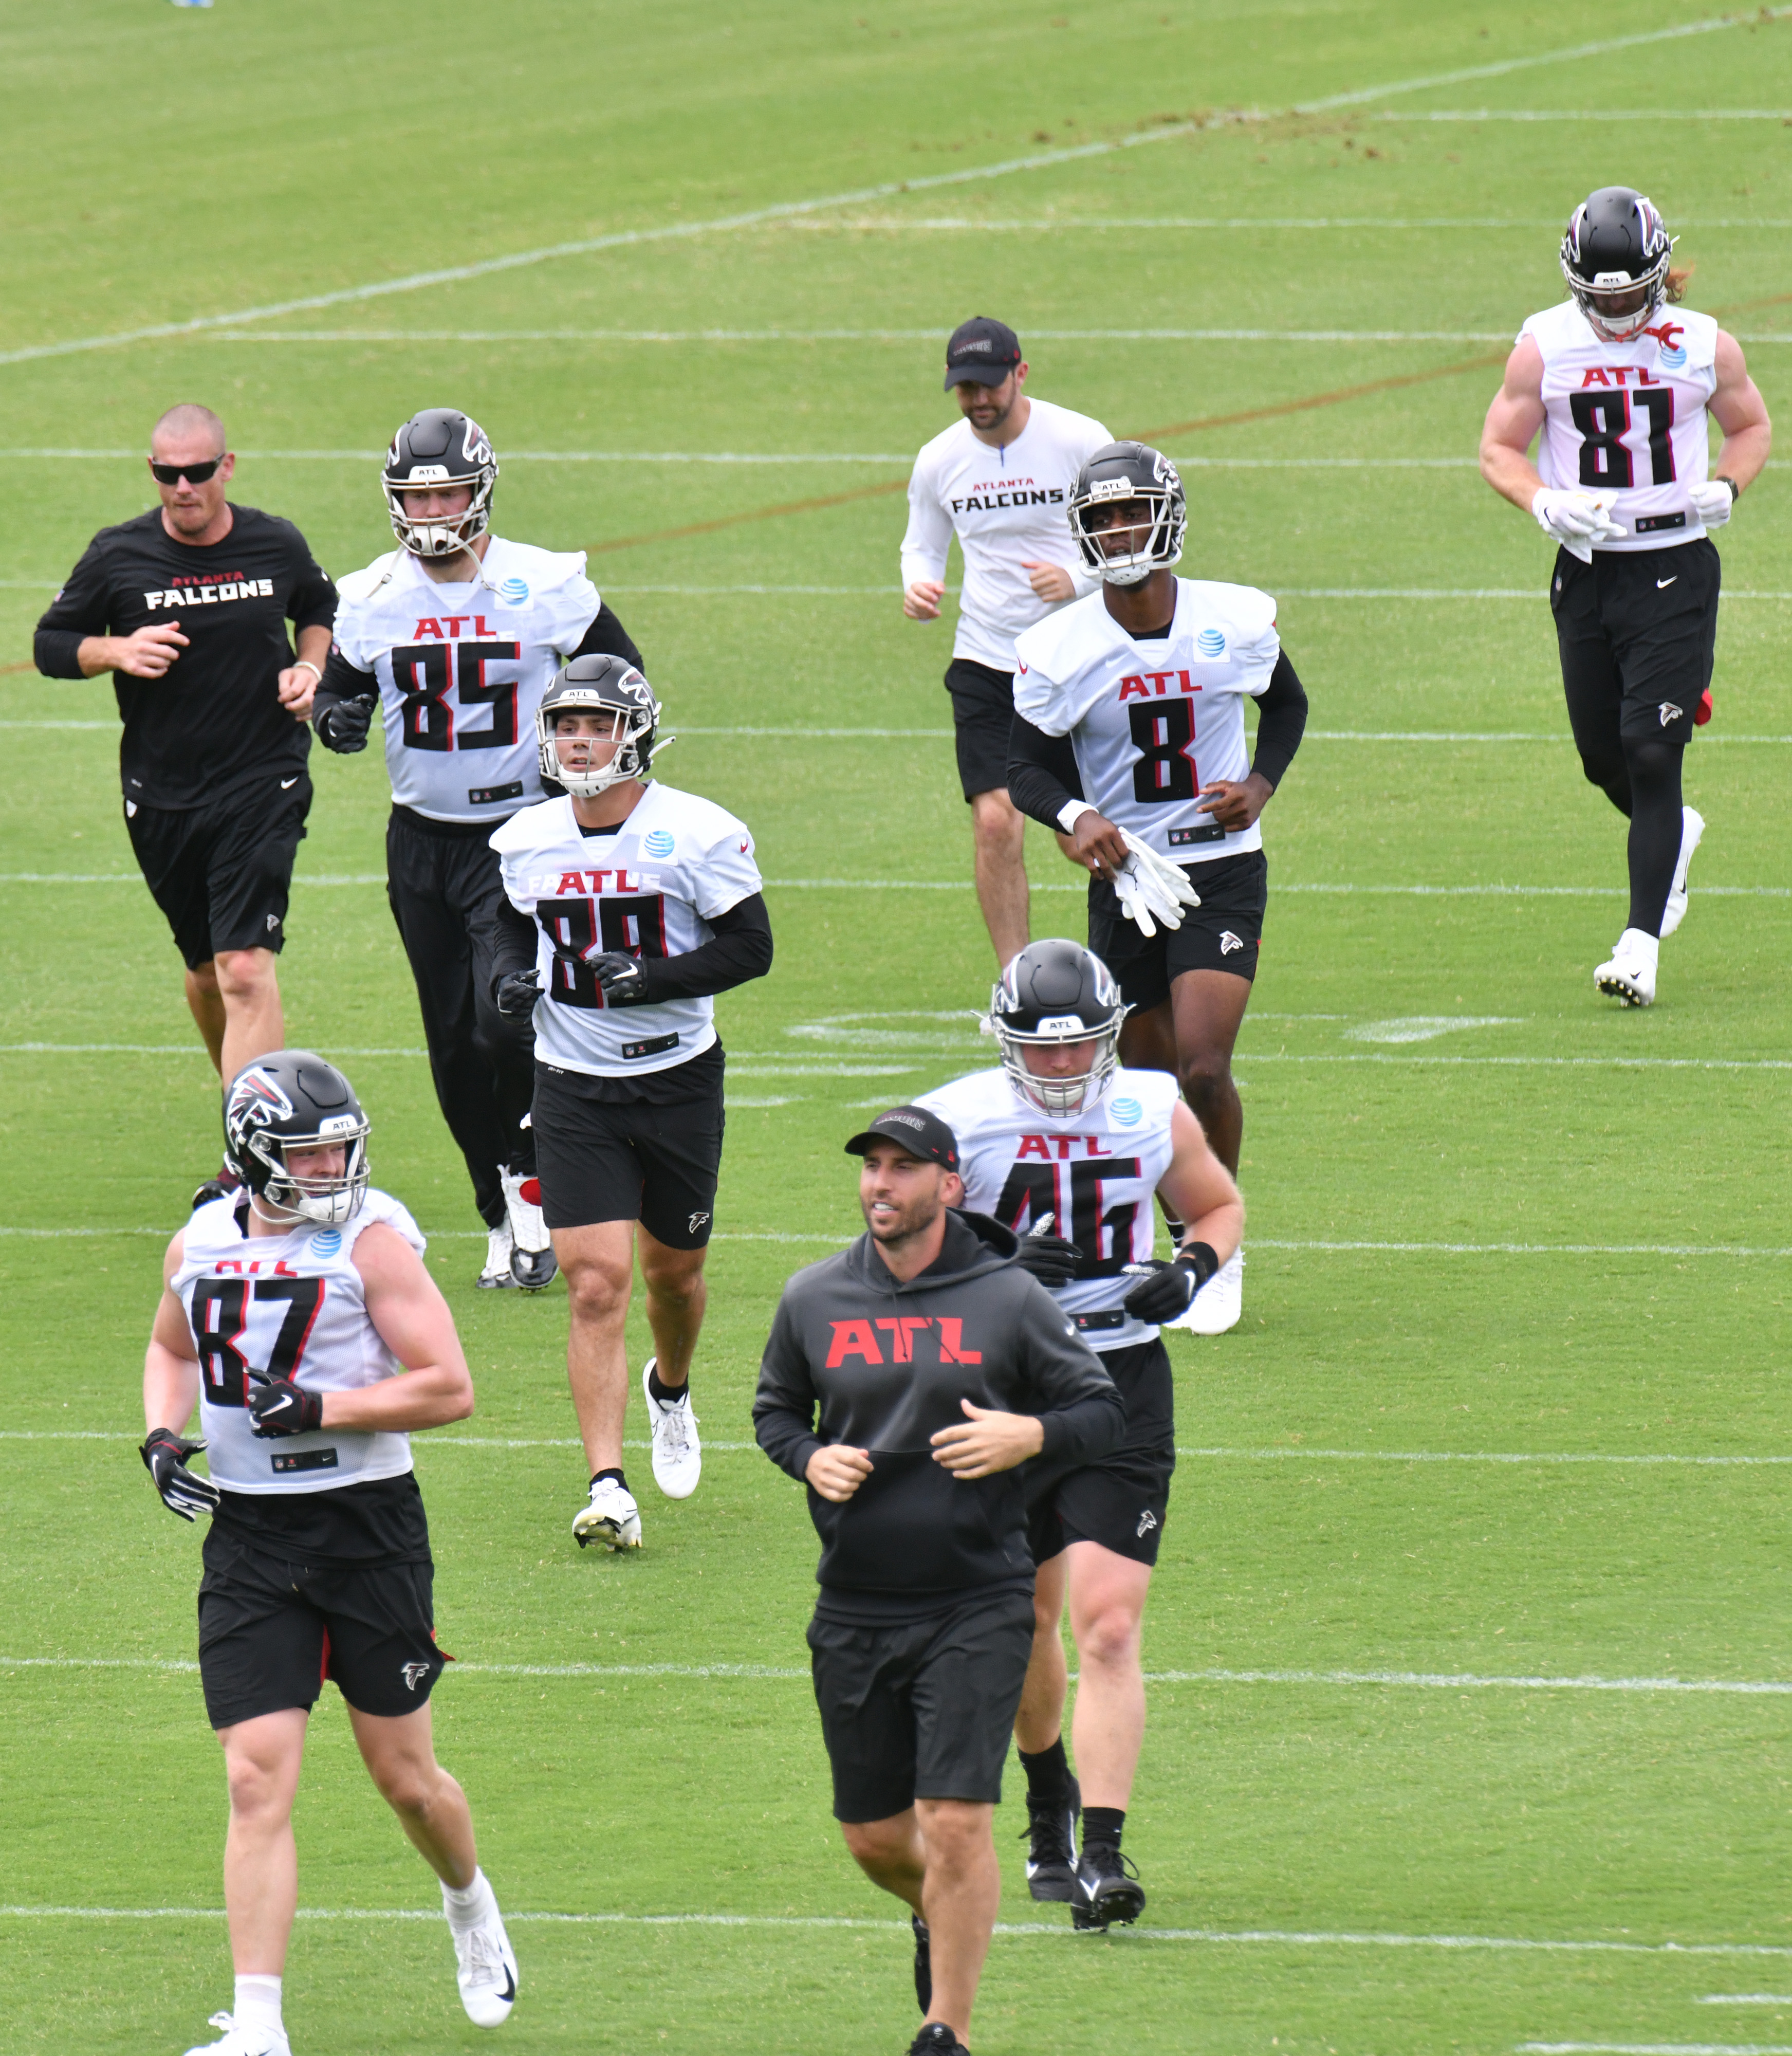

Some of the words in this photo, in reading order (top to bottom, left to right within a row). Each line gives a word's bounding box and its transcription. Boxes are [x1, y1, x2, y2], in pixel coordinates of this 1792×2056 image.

[1582, 367, 1660, 388] ATL
[1569, 387, 1677, 488] 81
[973, 478, 1034, 492] ATLANTA
[952, 488, 1063, 513] FALCONS
[172, 571, 244, 588] ATLANTA
[143, 579, 273, 610] FALCONS
[413, 616, 496, 640] ATL
[392, 641, 520, 751] 85
[1119, 670, 1203, 701] ATL
[1129, 697, 1199, 803] 8
[556, 869, 638, 895] ATL
[333, 1121, 350, 1130] ATL
[1016, 1135, 1112, 1160] ATL
[994, 1157, 1141, 1281] 46
[191, 1278, 325, 1408] 87
[825, 1317, 982, 1368] ATL
